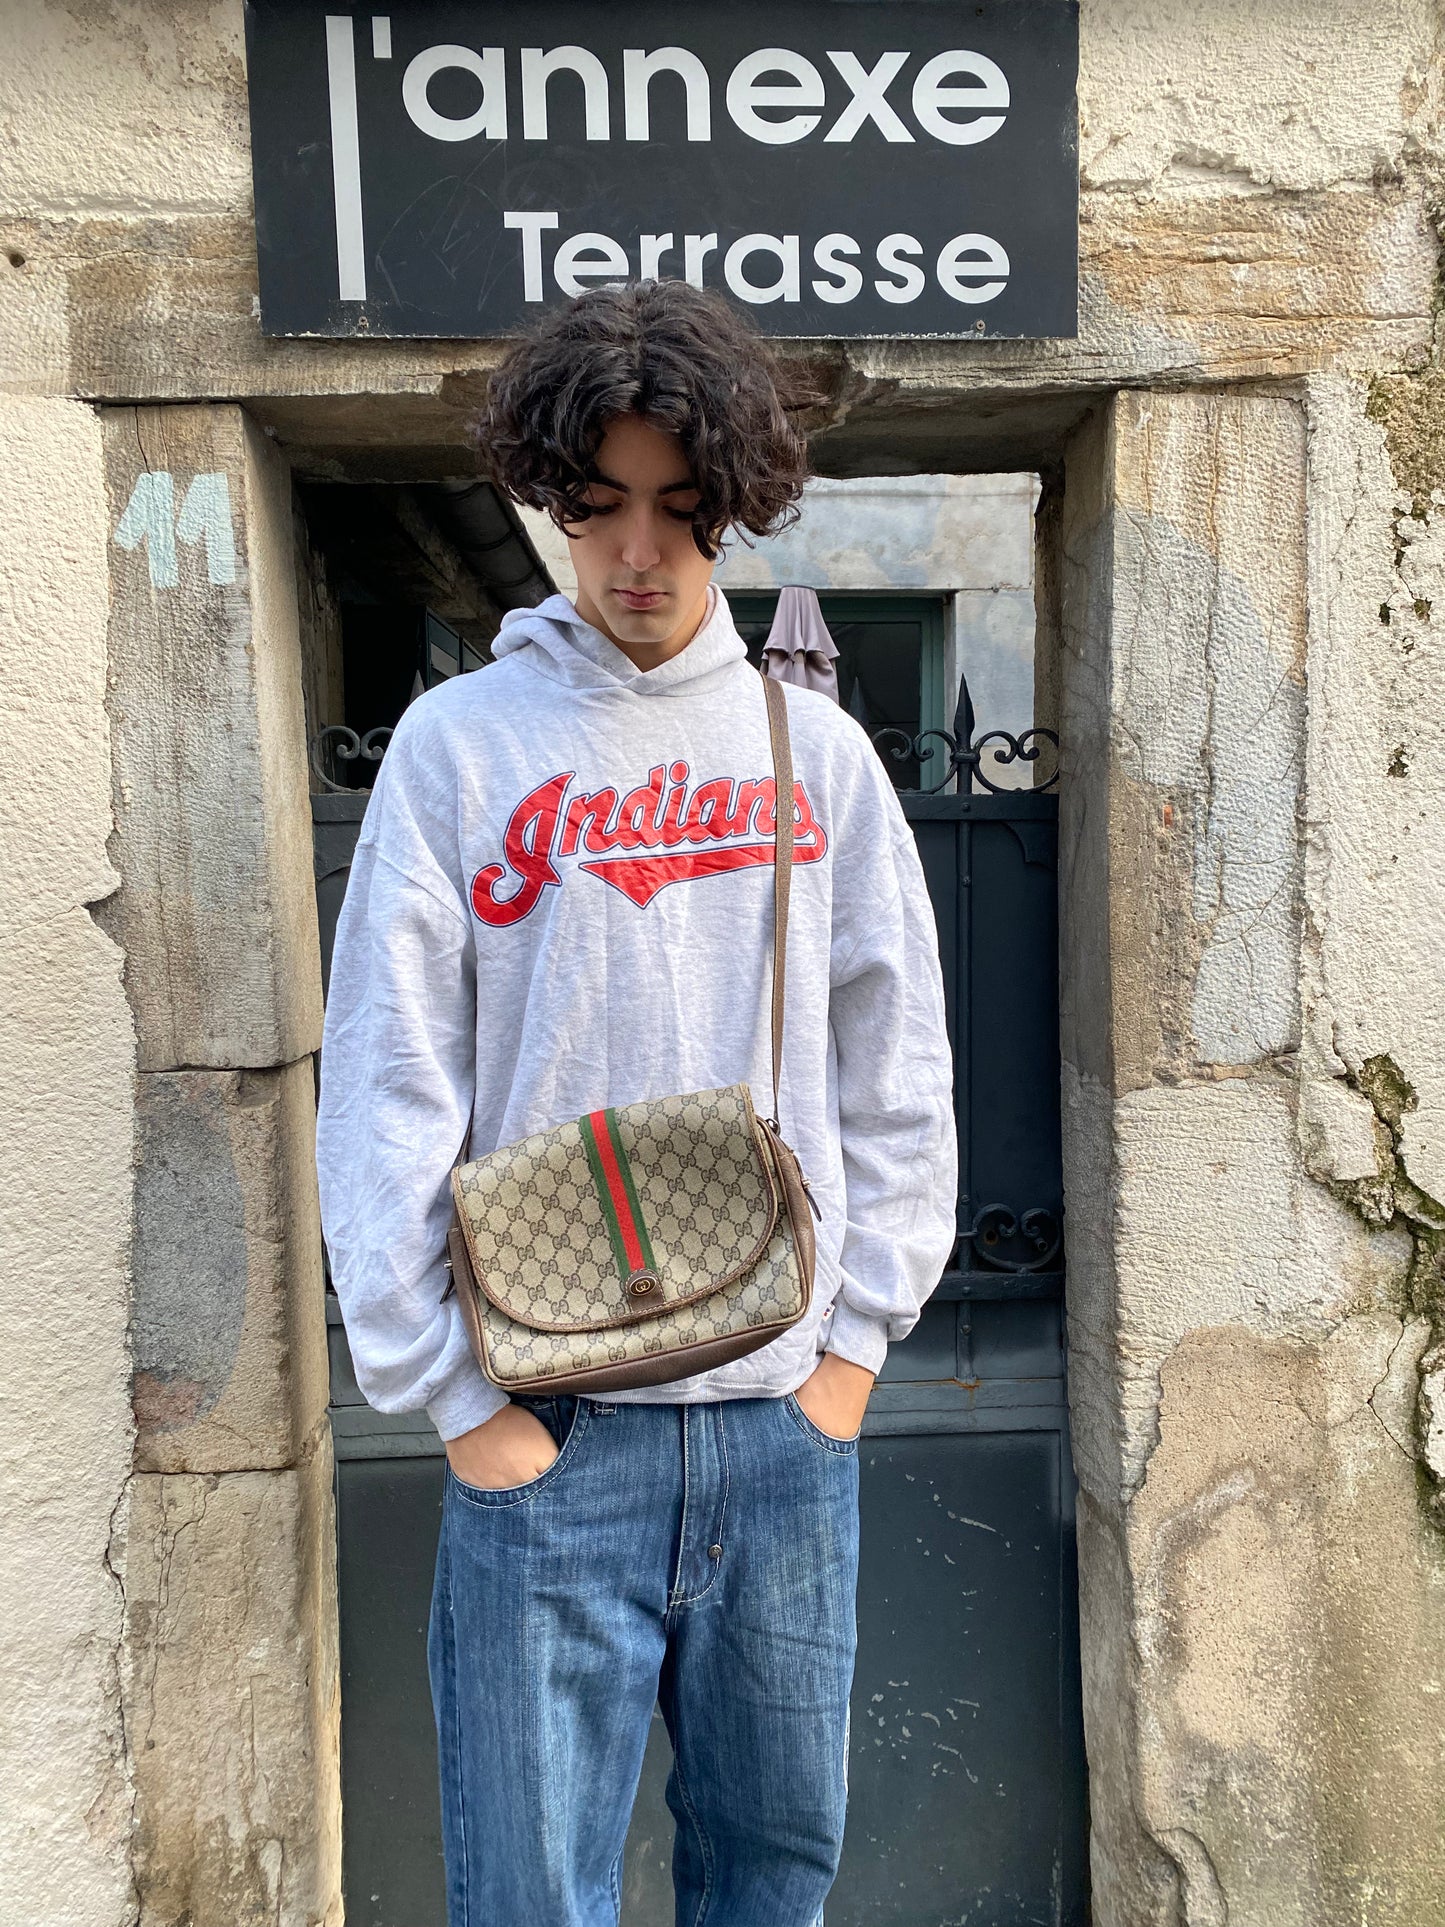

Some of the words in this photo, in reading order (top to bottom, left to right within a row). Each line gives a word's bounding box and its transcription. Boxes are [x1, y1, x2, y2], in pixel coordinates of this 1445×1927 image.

[325, 16, 1011, 301] l'annexe
[503, 211, 1011, 304] Terrasse
[113, 470, 236, 589] 11
[471, 759, 828, 928] Indians
